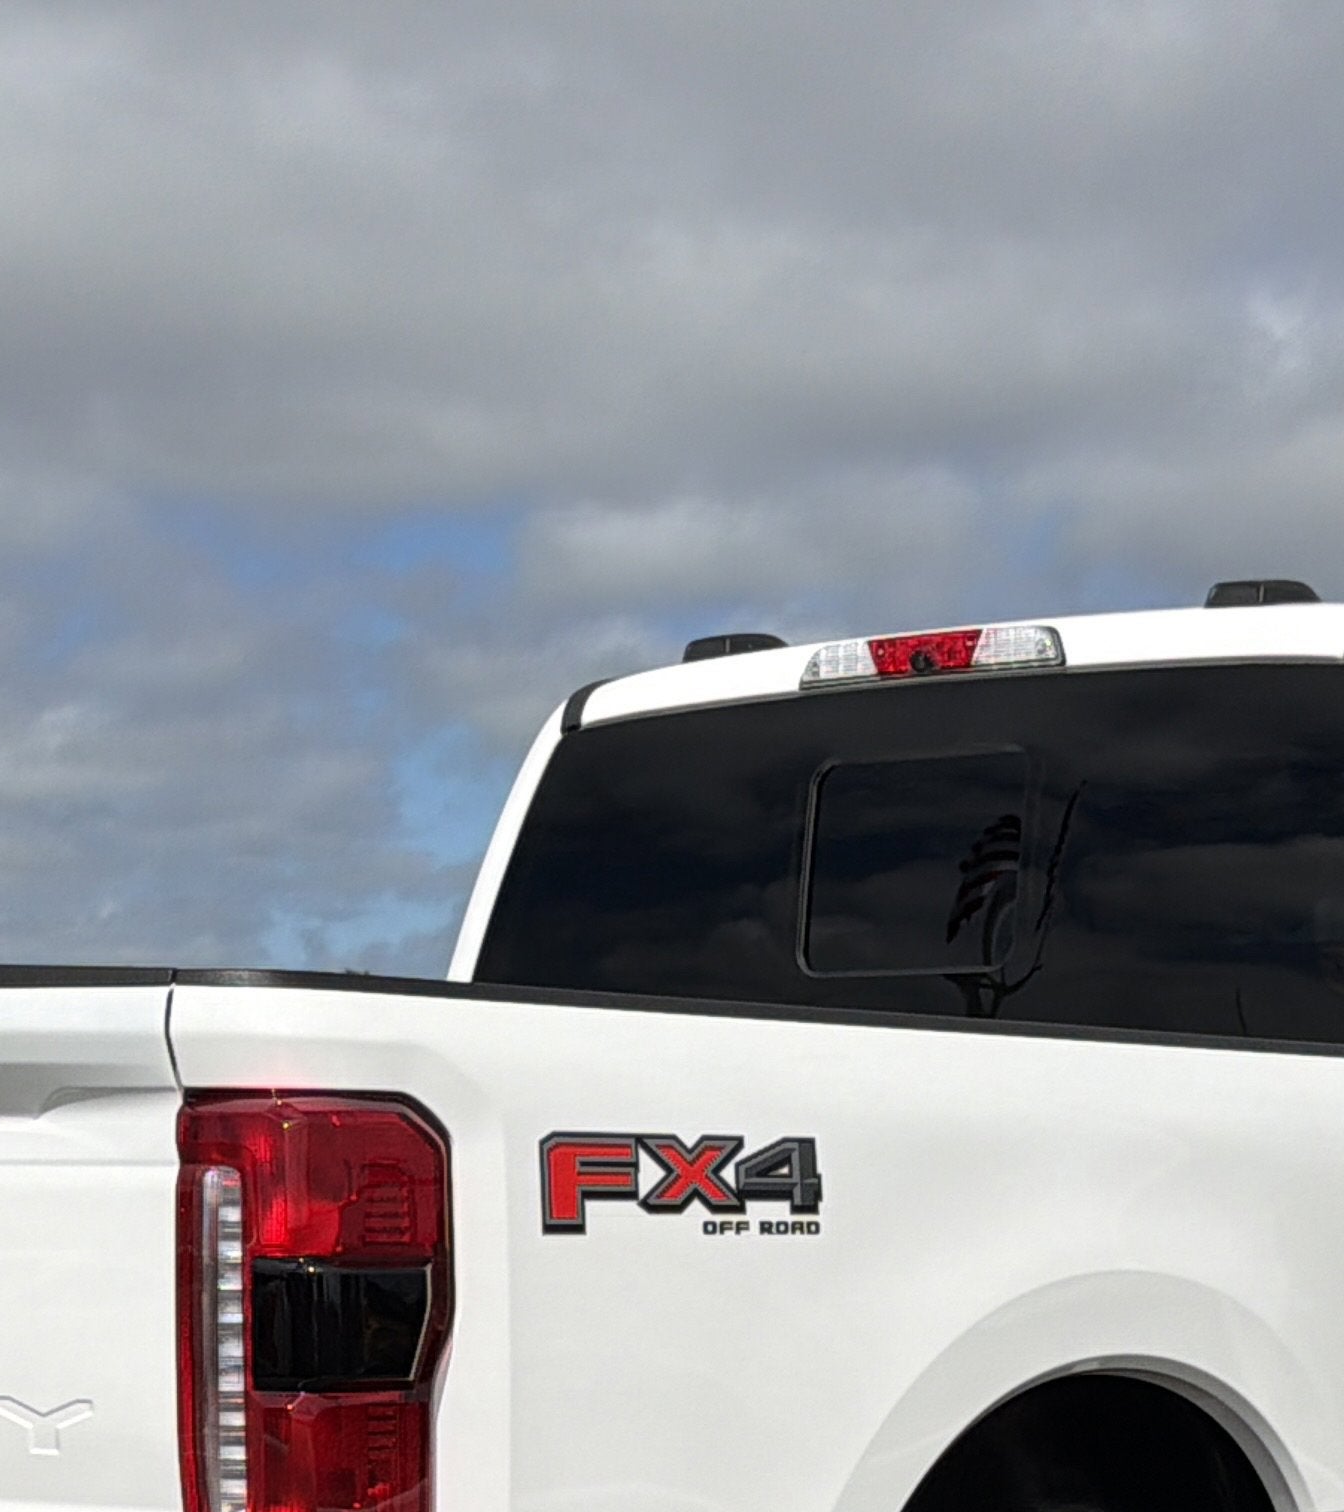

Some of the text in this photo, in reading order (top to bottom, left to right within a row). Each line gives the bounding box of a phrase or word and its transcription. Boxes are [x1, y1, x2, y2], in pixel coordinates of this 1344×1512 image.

[538, 1130, 823, 1236] FX4
[702, 1220, 821, 1235] OFF ROAD
